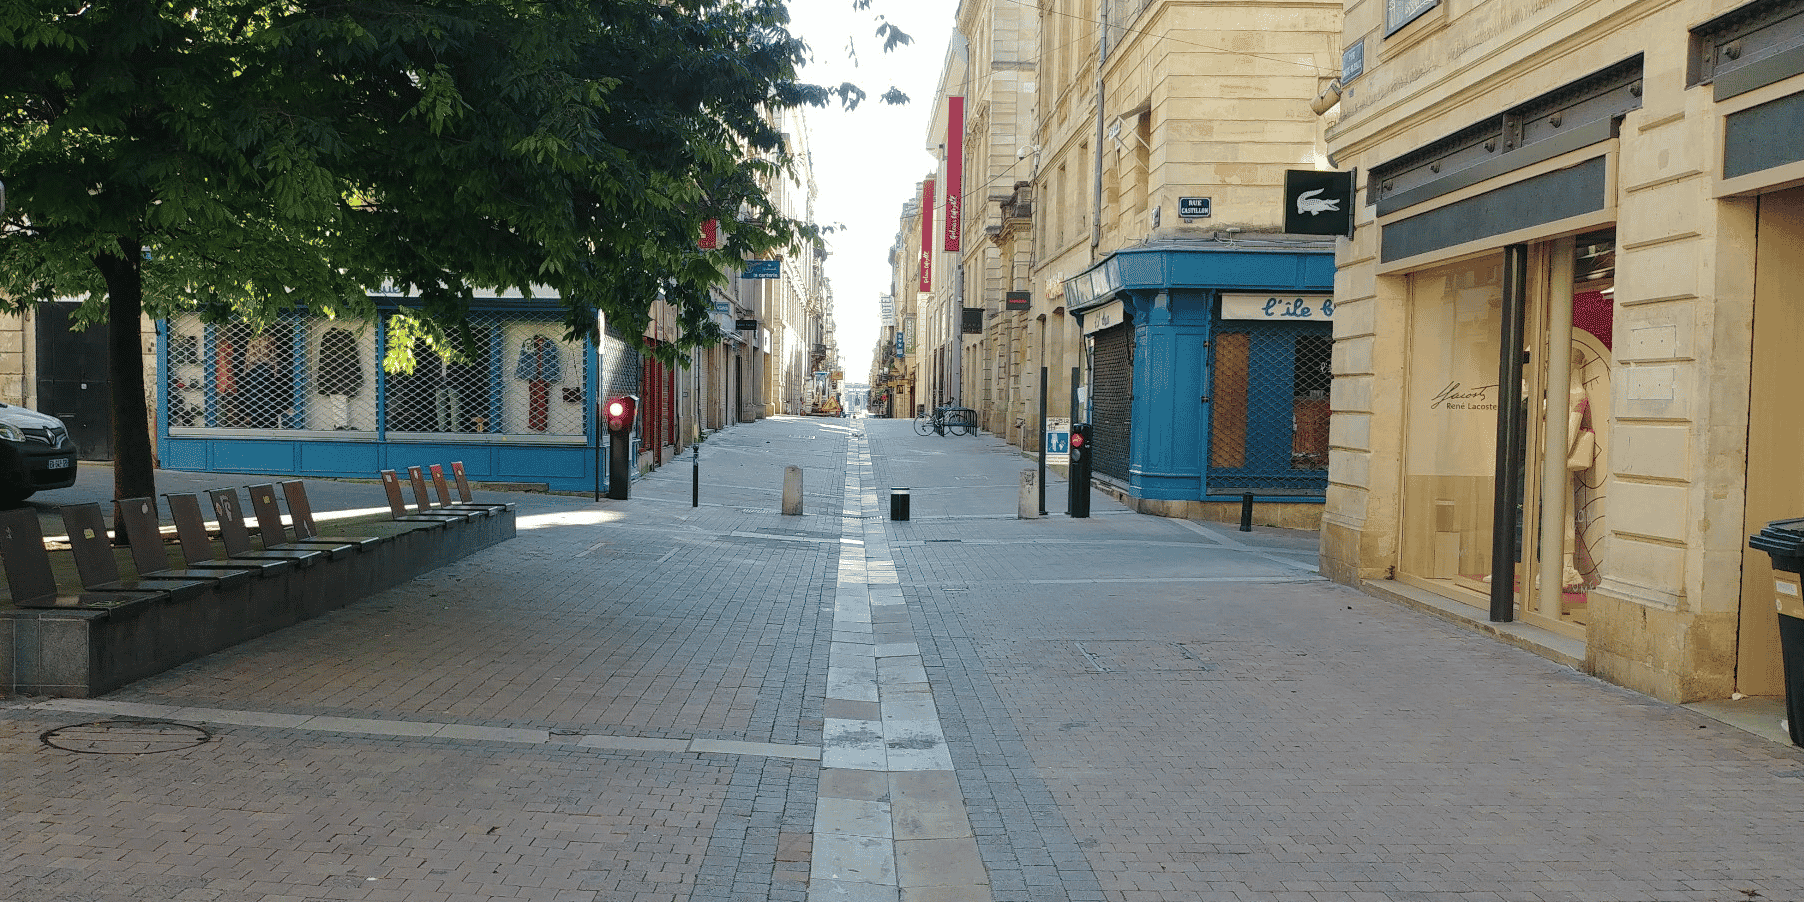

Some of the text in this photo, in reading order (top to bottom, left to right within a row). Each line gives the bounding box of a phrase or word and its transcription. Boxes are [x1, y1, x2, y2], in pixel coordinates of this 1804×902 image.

[1261, 298, 1312, 317] l'île
[1446, 402, 1497, 411] René Lacoste
